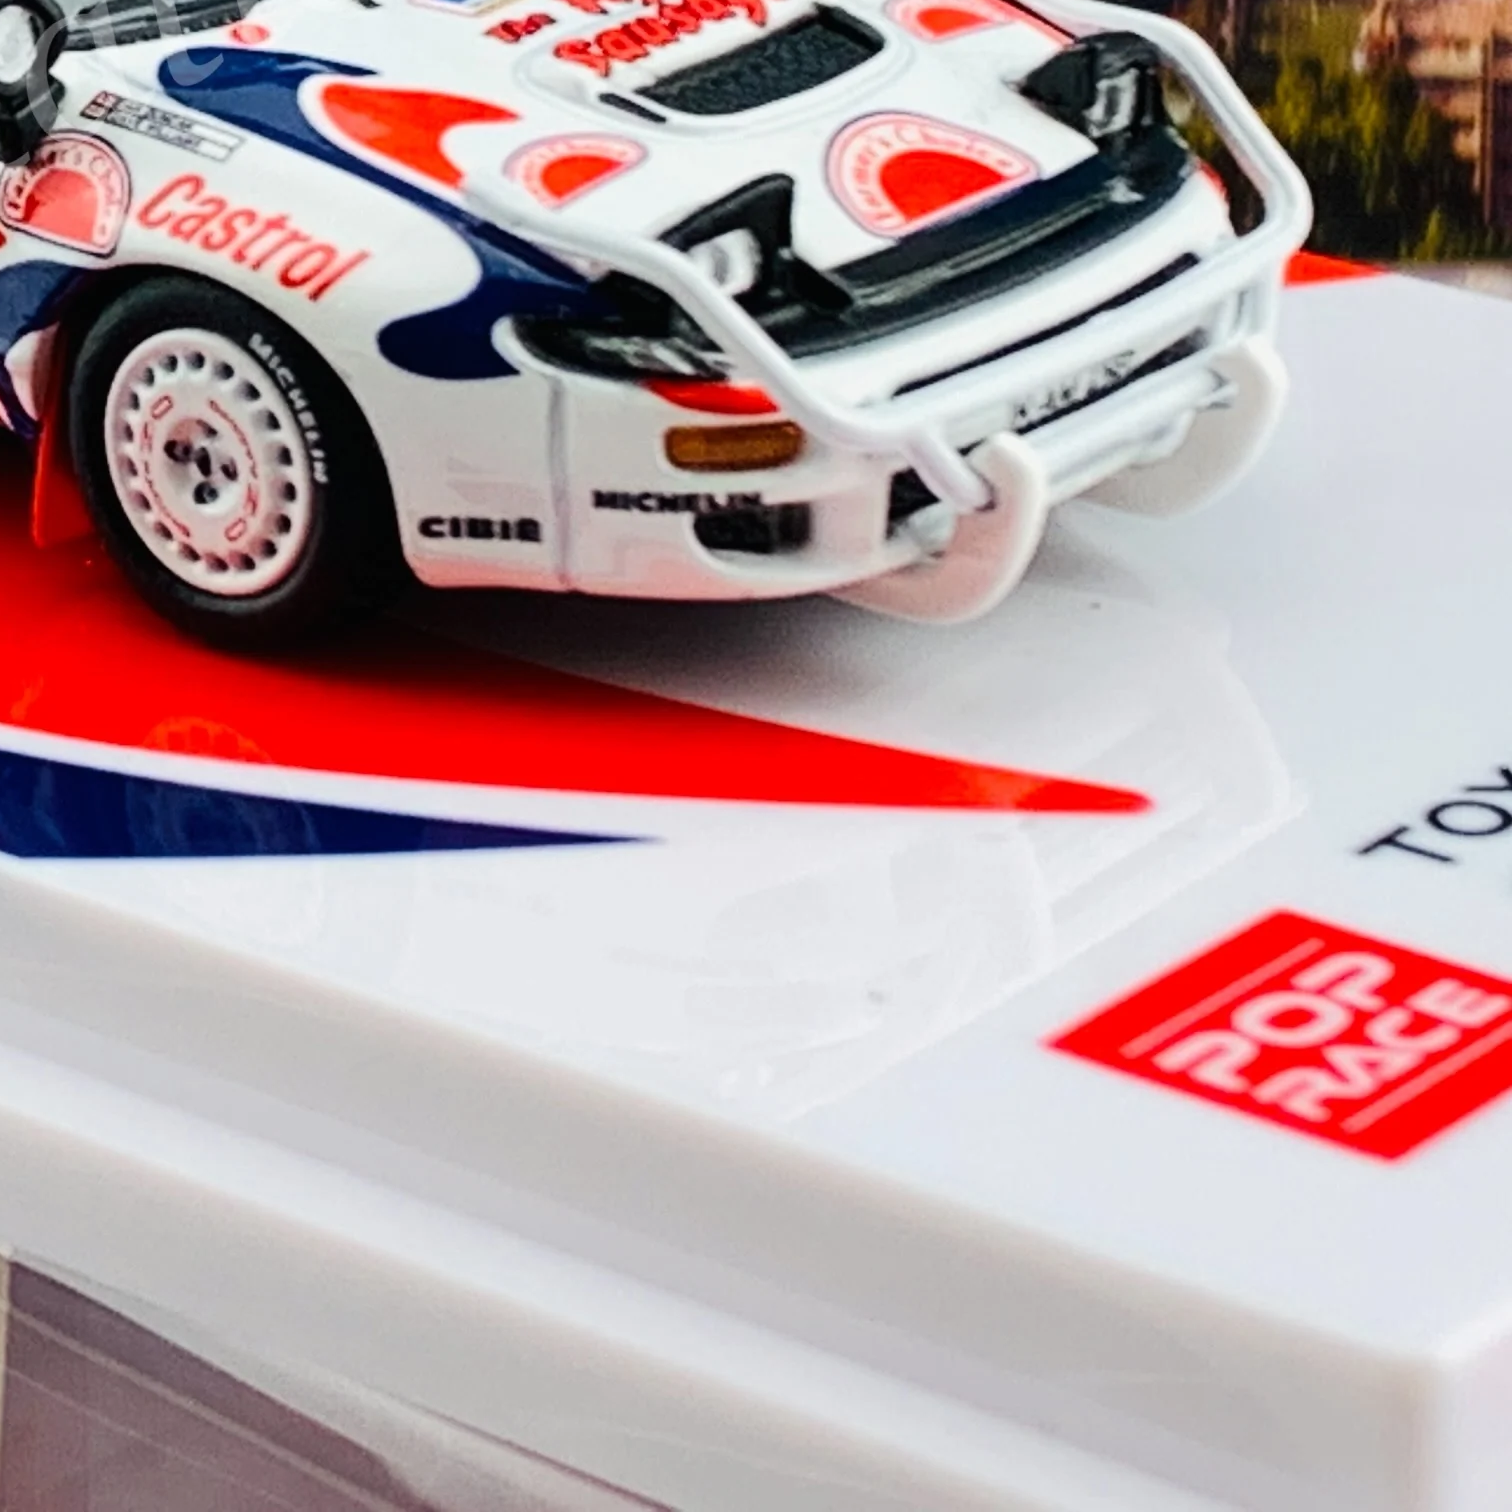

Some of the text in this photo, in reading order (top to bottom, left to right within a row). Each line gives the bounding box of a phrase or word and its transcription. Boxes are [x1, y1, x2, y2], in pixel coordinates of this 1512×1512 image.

[137, 173, 373, 303] Castrol
[1151, 950, 1396, 1092] POP
[1249, 978, 1512, 1123] RACE
